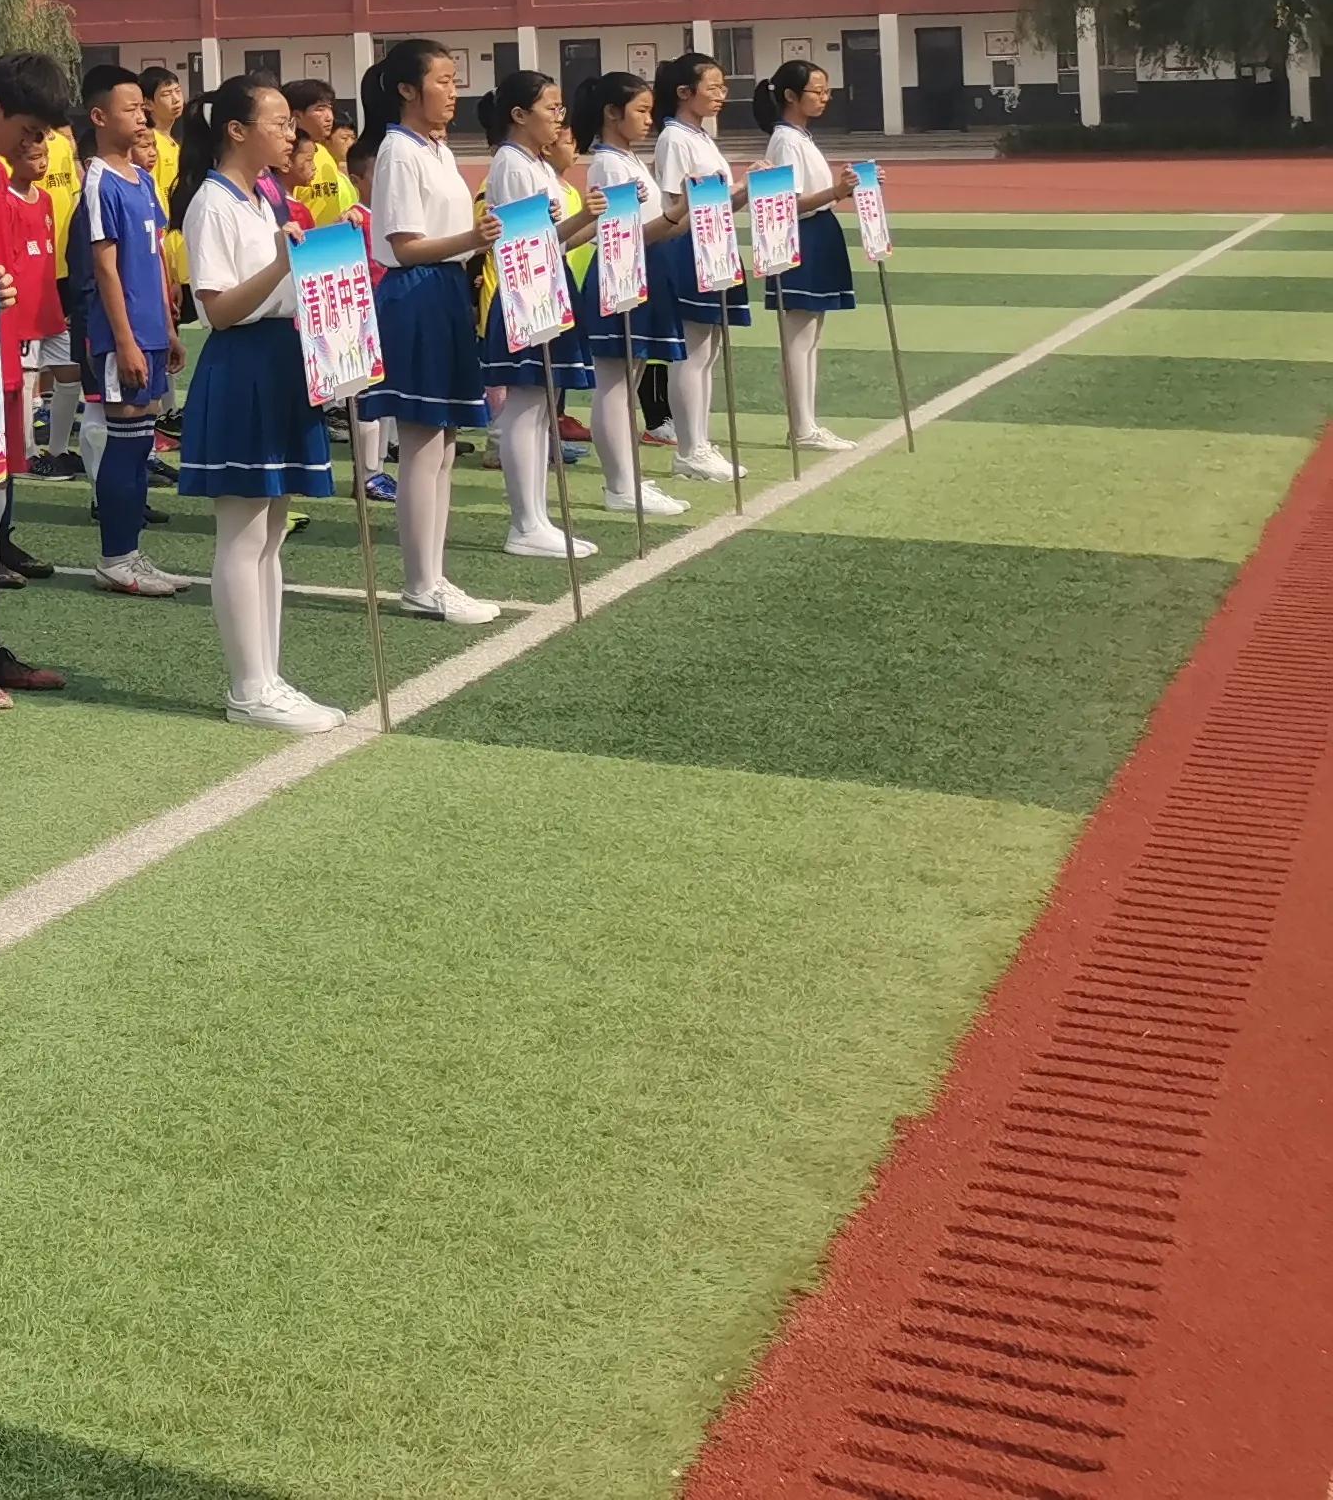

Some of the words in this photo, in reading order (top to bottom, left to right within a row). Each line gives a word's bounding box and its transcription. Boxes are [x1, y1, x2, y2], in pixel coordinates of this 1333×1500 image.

[499, 229, 559, 292] 高新二小
[301, 263, 370, 337] 清源中学
